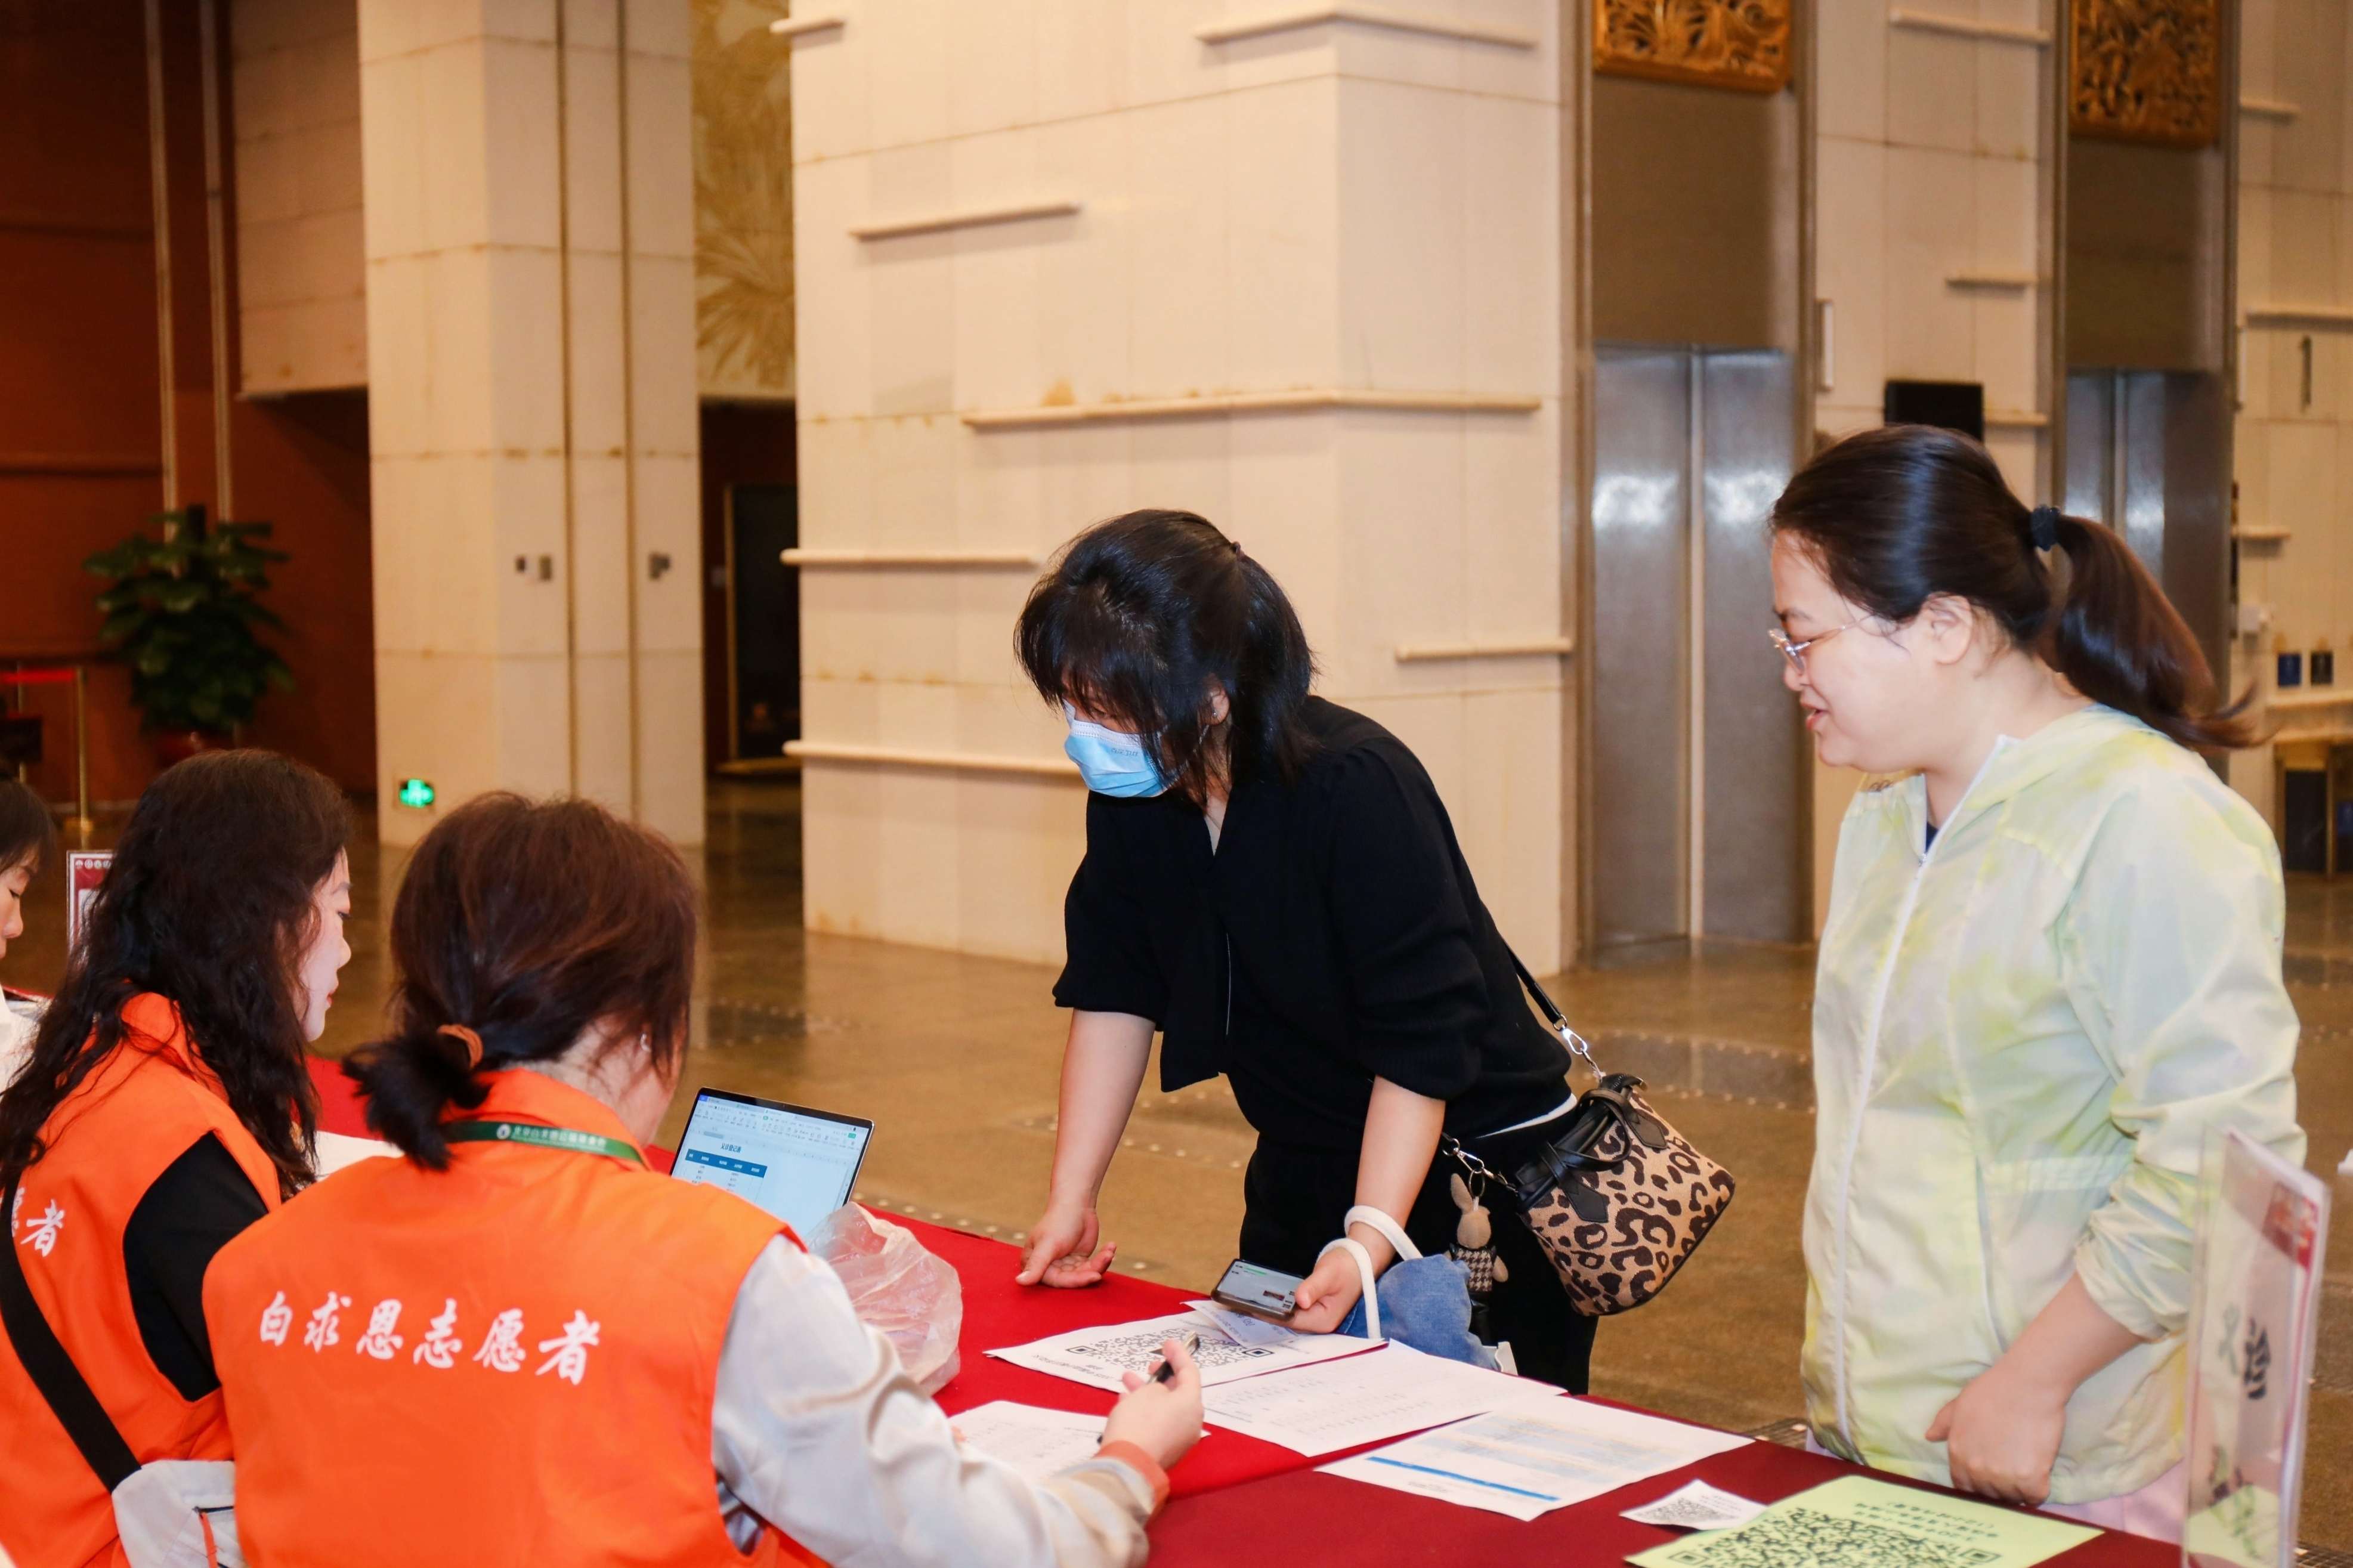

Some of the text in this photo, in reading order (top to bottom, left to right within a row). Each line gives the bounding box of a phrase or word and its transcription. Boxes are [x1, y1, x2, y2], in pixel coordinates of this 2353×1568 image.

[259, 1291, 600, 1385] 白求恩志愿者
